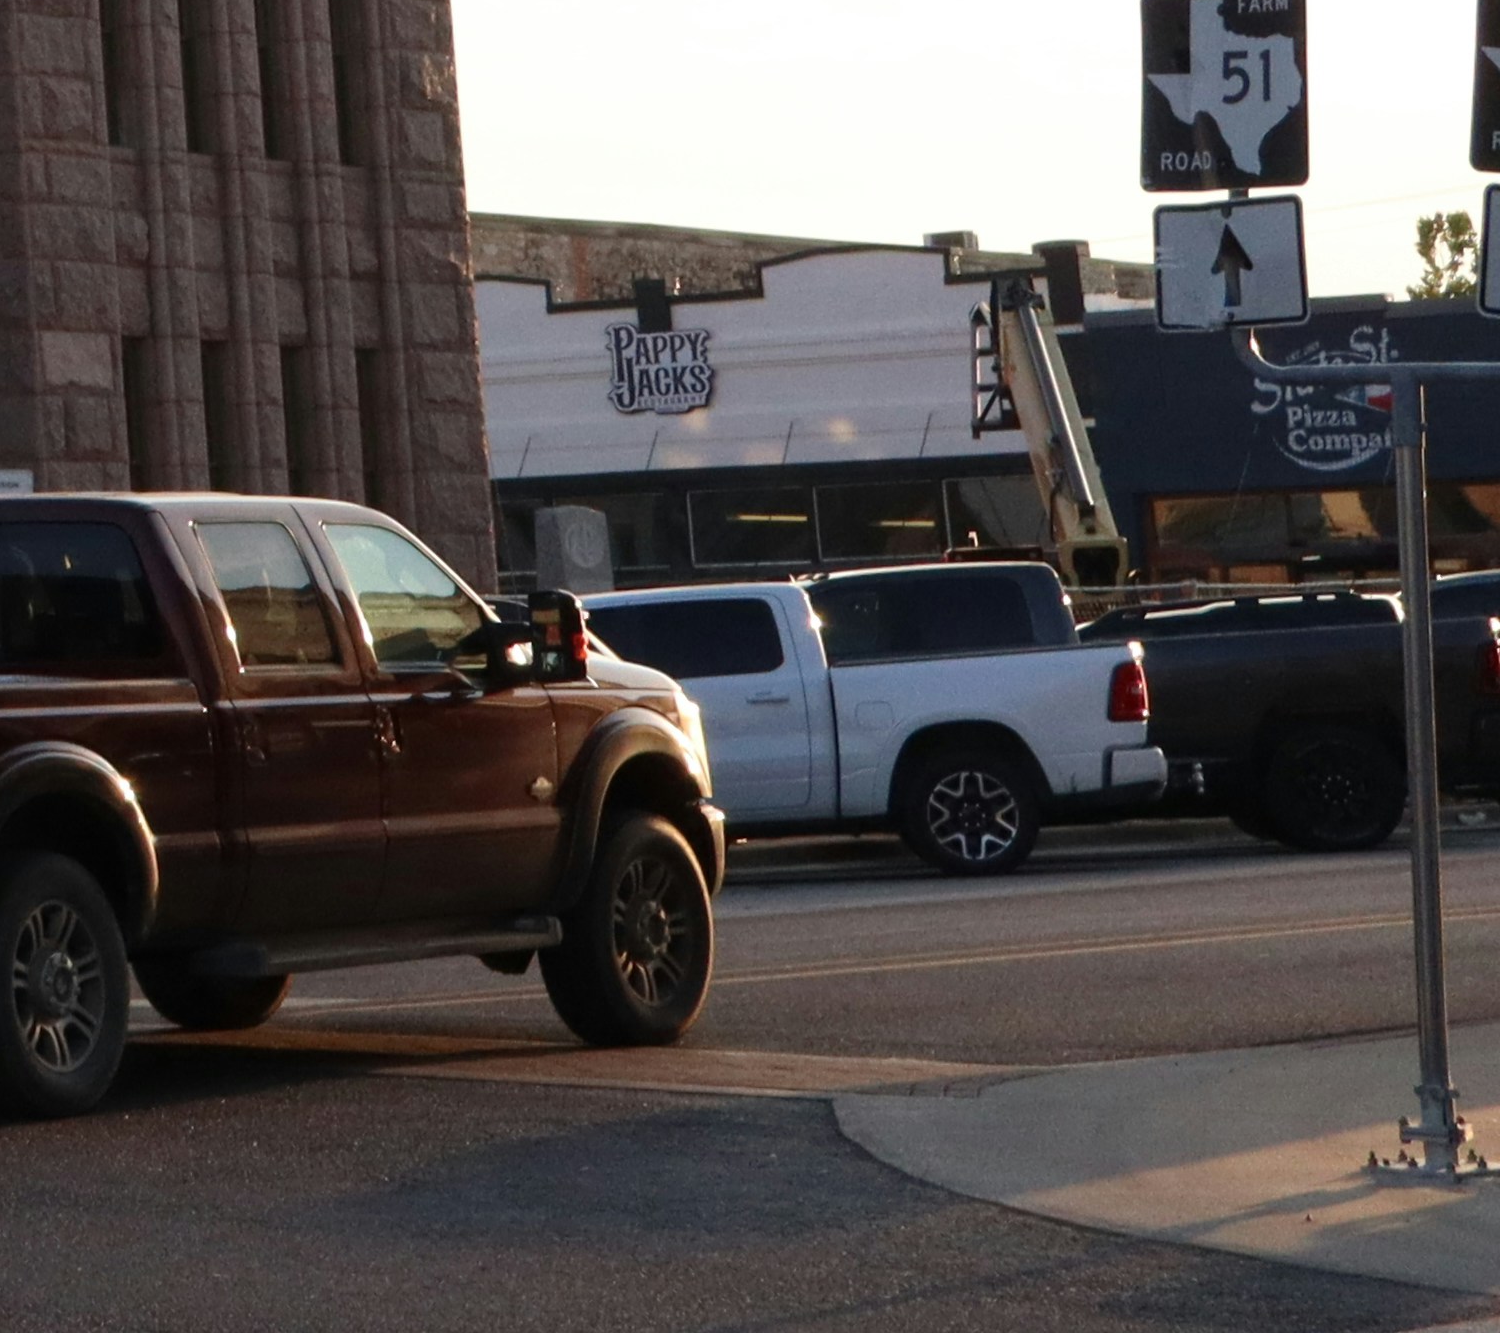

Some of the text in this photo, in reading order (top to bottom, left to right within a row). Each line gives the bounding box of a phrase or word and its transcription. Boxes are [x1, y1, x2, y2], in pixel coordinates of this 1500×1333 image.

[1222, 49, 1273, 105] 51
[1159, 151, 1213, 173] ROAD
[613, 325, 702, 383] PAPPY
[615, 357, 707, 409] JACKS
[1286, 404, 1357, 428] Pizza
[1287, 429, 1393, 456] Compa
